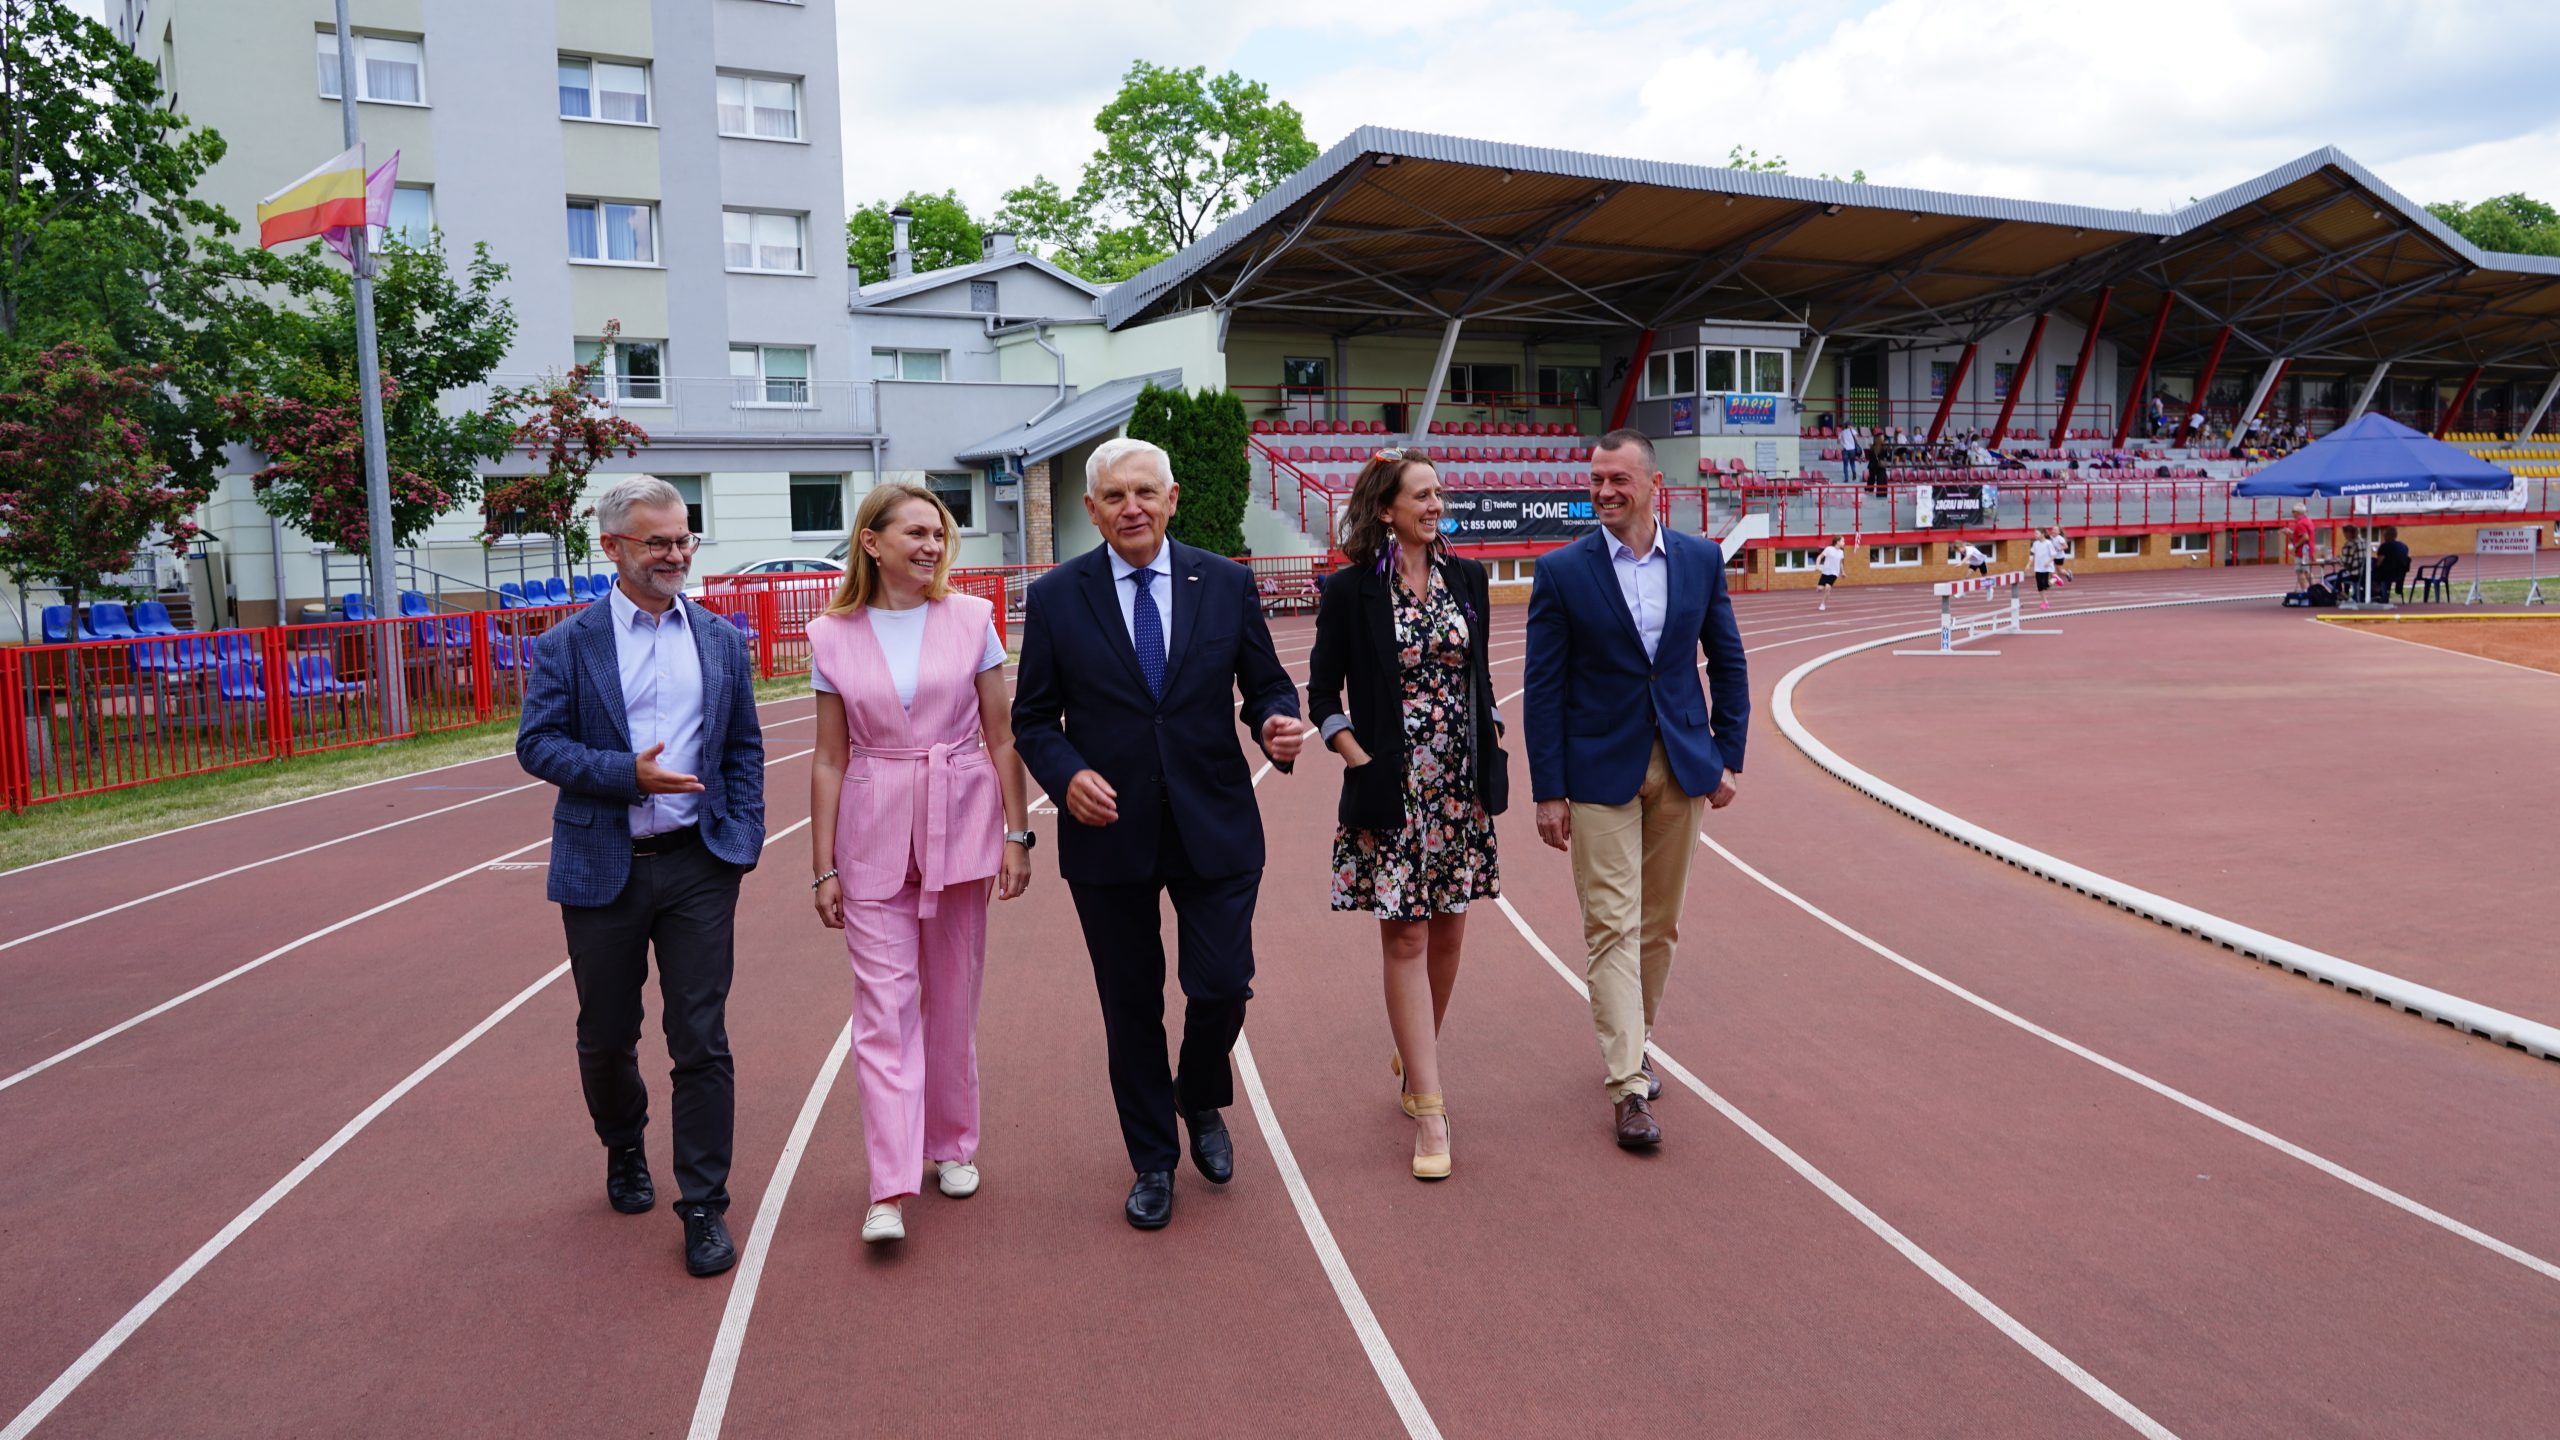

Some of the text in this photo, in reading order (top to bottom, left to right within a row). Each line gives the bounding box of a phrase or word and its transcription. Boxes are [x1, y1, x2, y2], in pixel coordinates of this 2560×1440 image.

[1493, 501, 1517, 509] Telefon
[1470, 519, 1517, 530] 855 000 000
